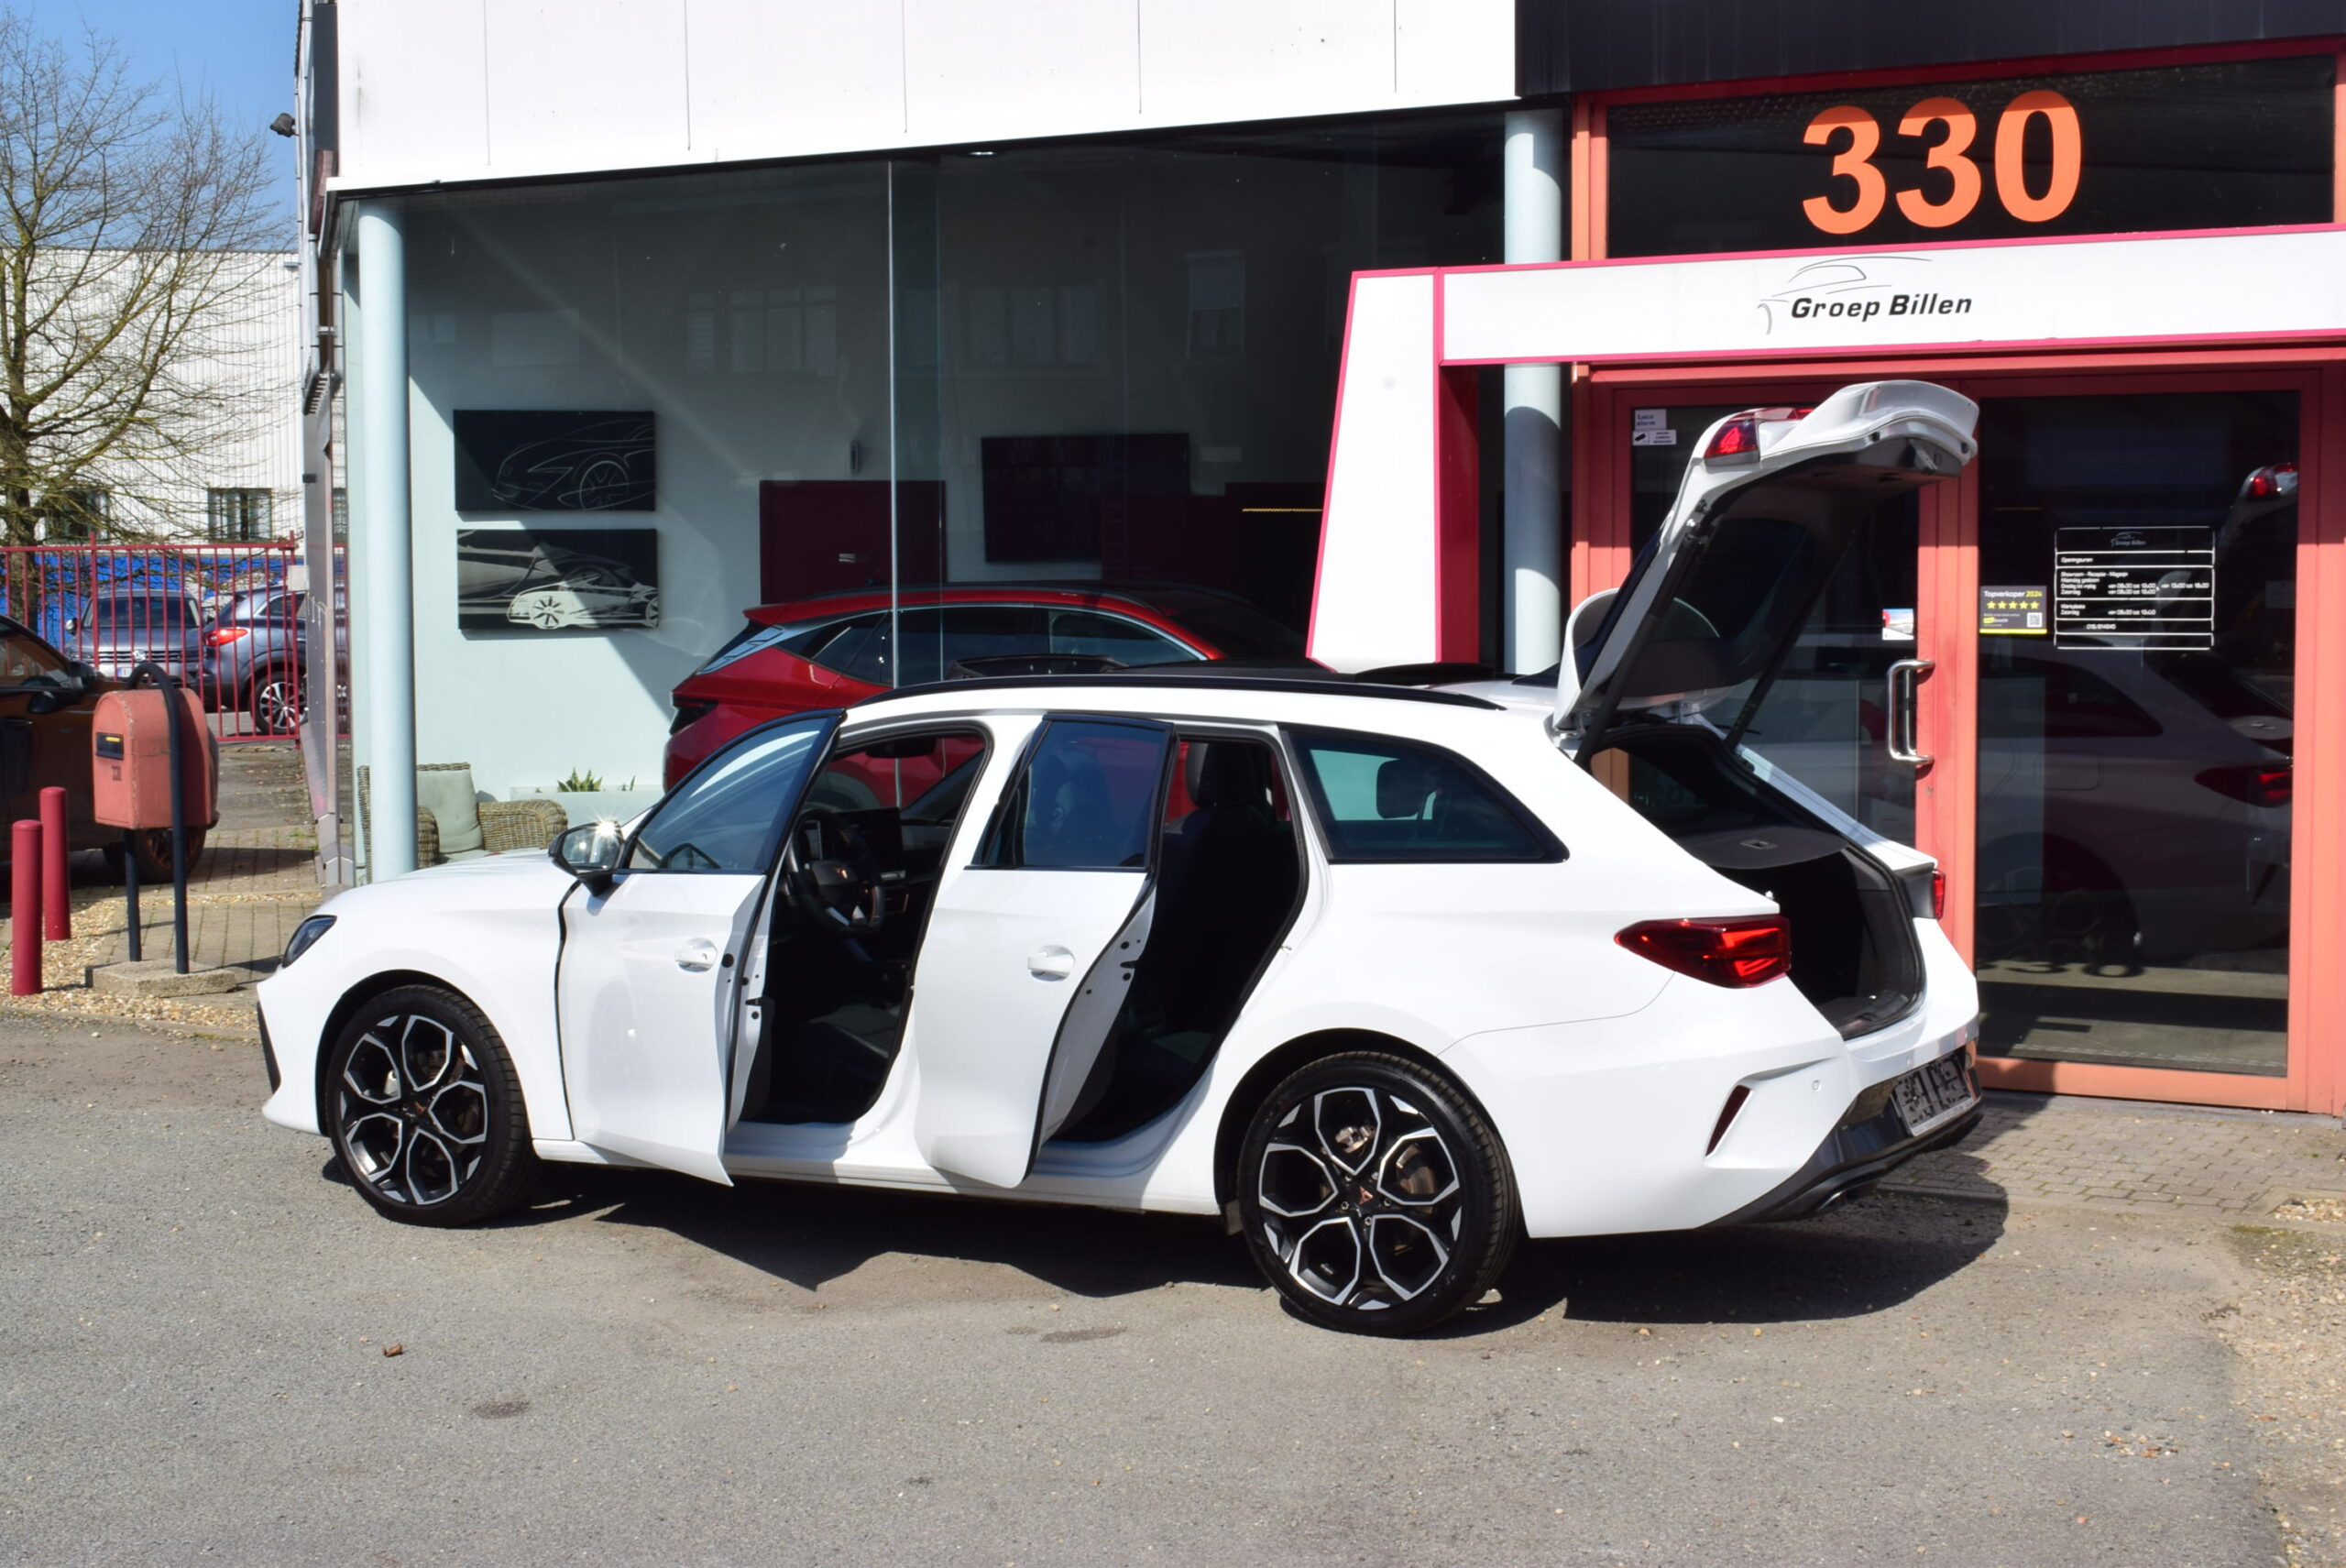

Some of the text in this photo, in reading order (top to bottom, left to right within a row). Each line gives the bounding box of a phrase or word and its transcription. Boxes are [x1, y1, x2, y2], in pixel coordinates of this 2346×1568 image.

[1802, 89, 2081, 235] 330
[1791, 292, 1972, 322] Groep Billen
